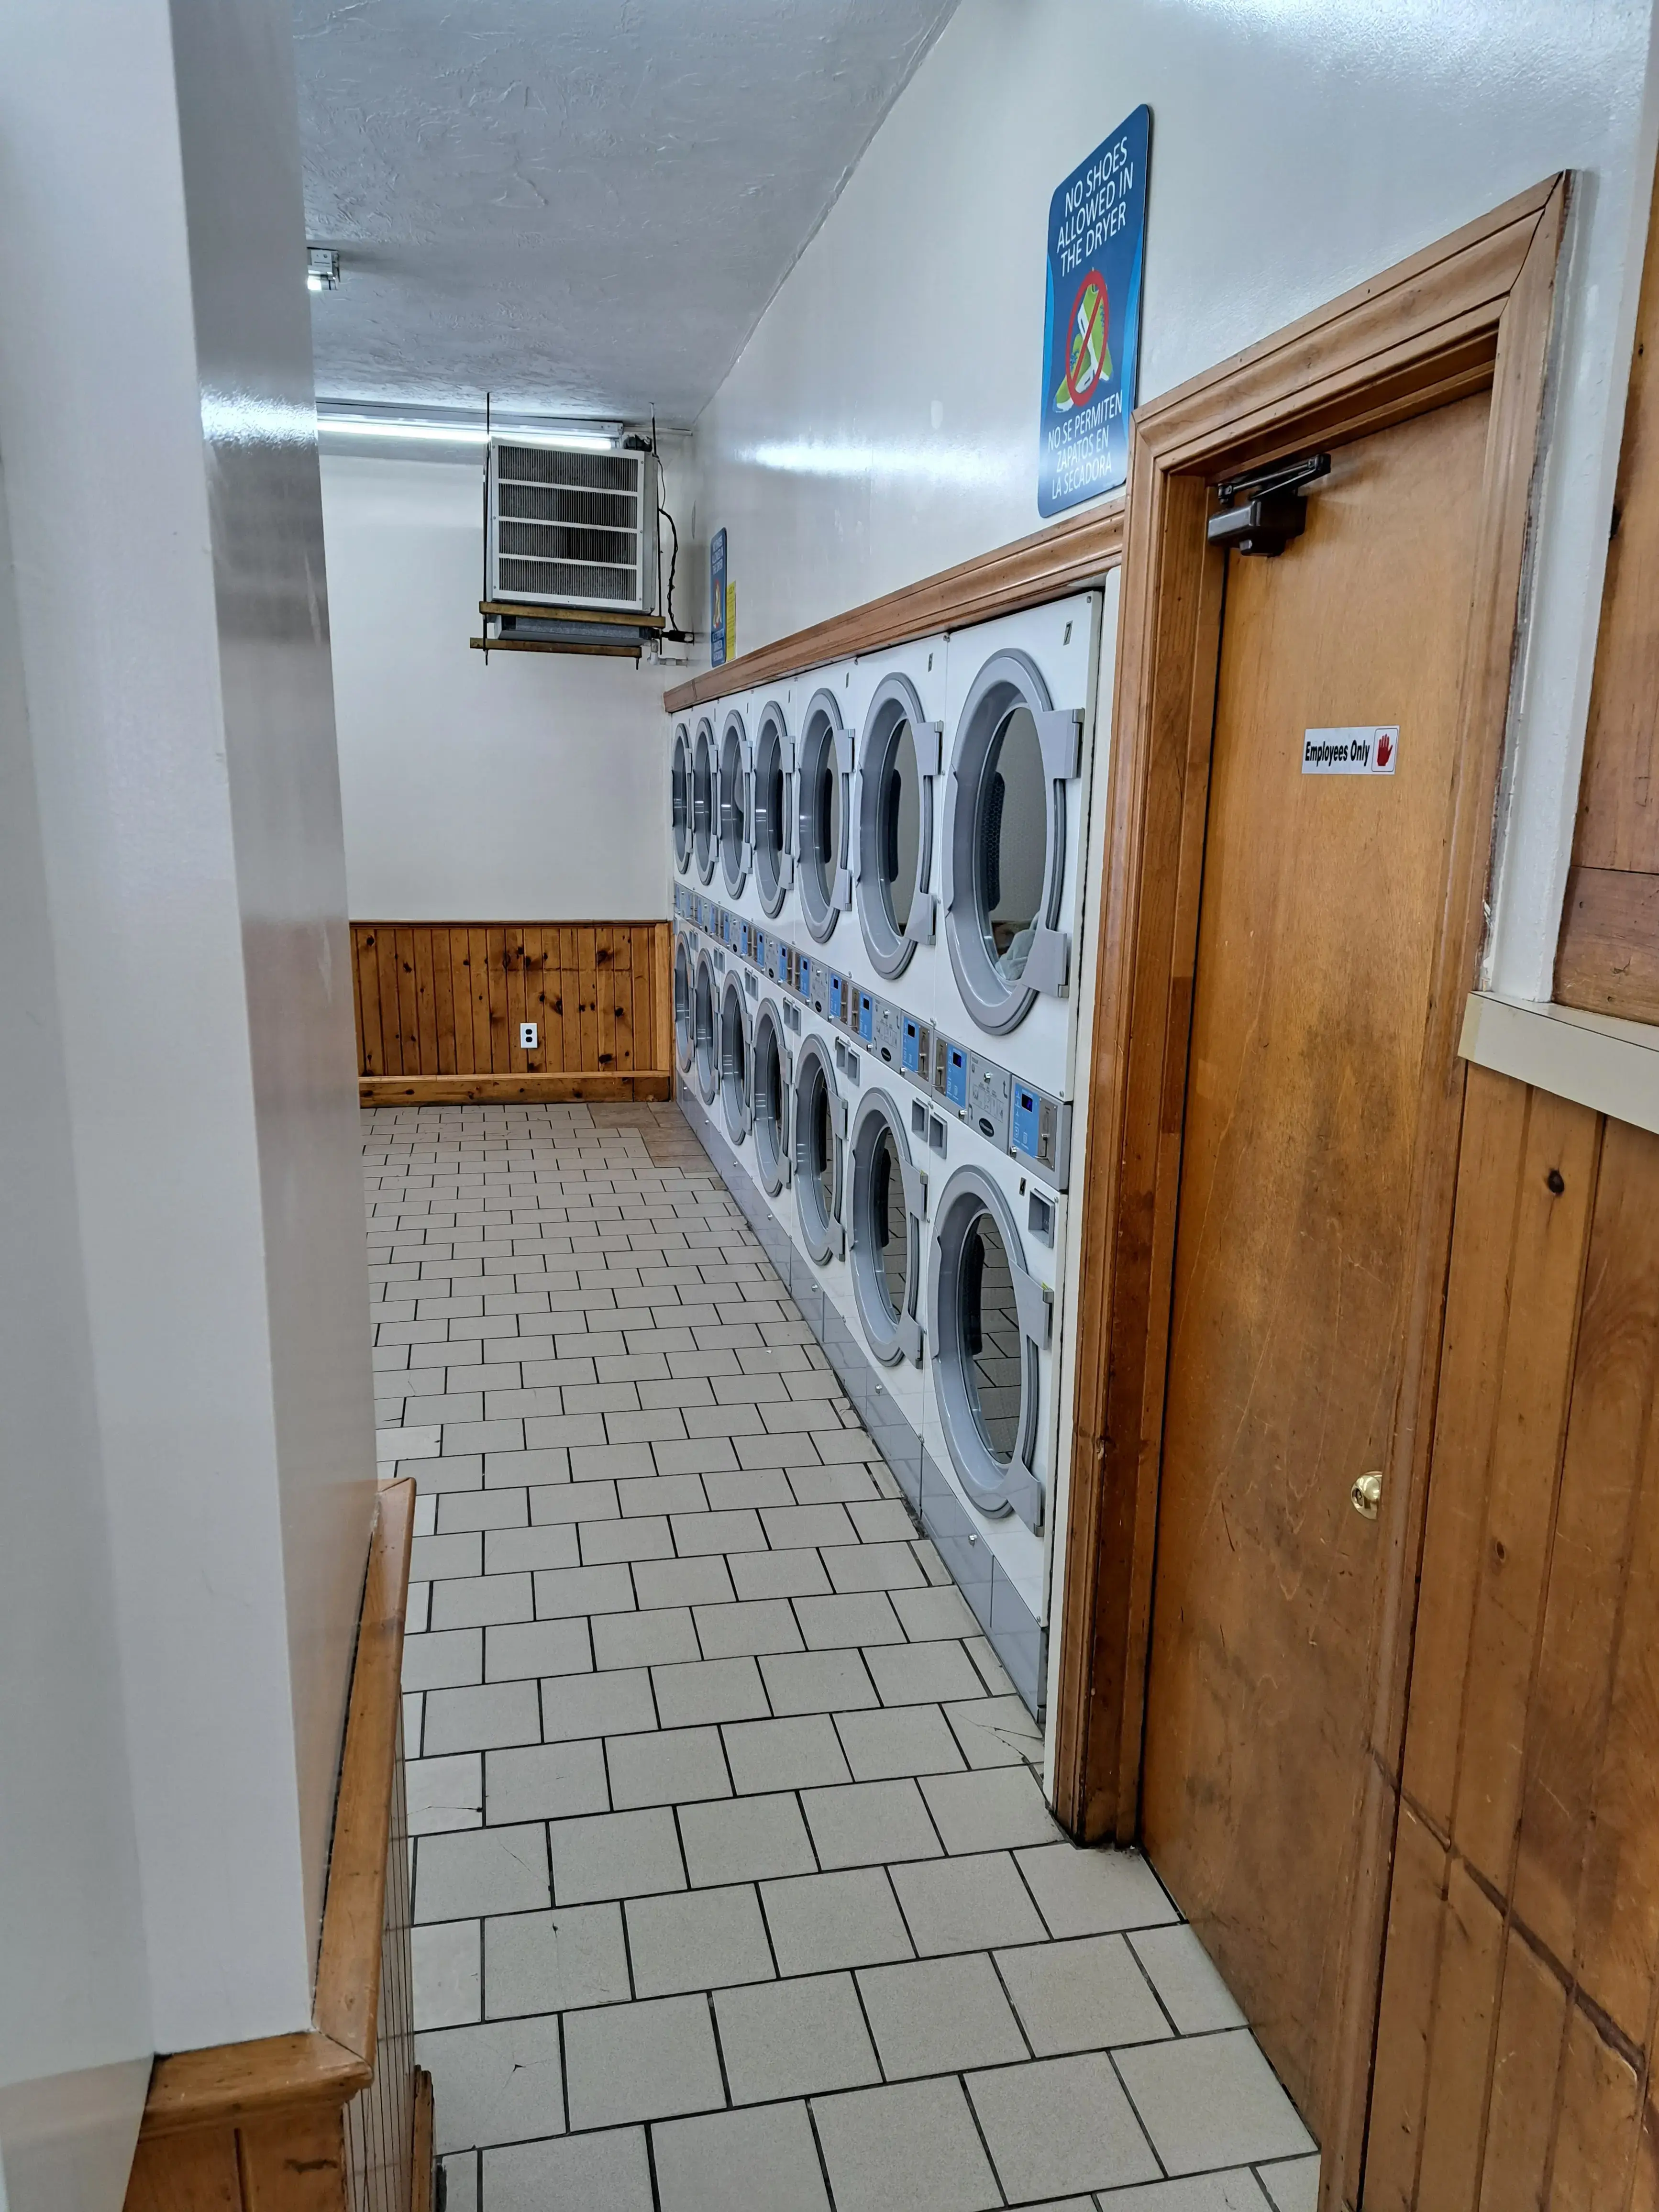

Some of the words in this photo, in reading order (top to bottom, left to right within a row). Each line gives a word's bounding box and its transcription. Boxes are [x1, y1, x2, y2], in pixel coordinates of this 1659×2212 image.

[1056, 181, 1116, 254] ALLOWED
[1119, 161, 1133, 199] IN
[1065, 180, 1083, 217] NO
[1086, 136, 1128, 197] SHOES
[1061, 237, 1083, 277] THE
[1086, 201, 1126, 257] DRYER
[1048, 426, 1061, 453] NO
[1062, 419, 1073, 444] SE
[1074, 389, 1123, 438] PERMITEN
[1056, 433, 1094, 473] ZAPATOS
[1096, 425, 1109, 453] EN
[1052, 476, 1062, 500] LA
[1063, 452, 1112, 494] SECADORA
[1305, 741, 1348, 767] Employees
[1350, 740, 1370, 766] Only
